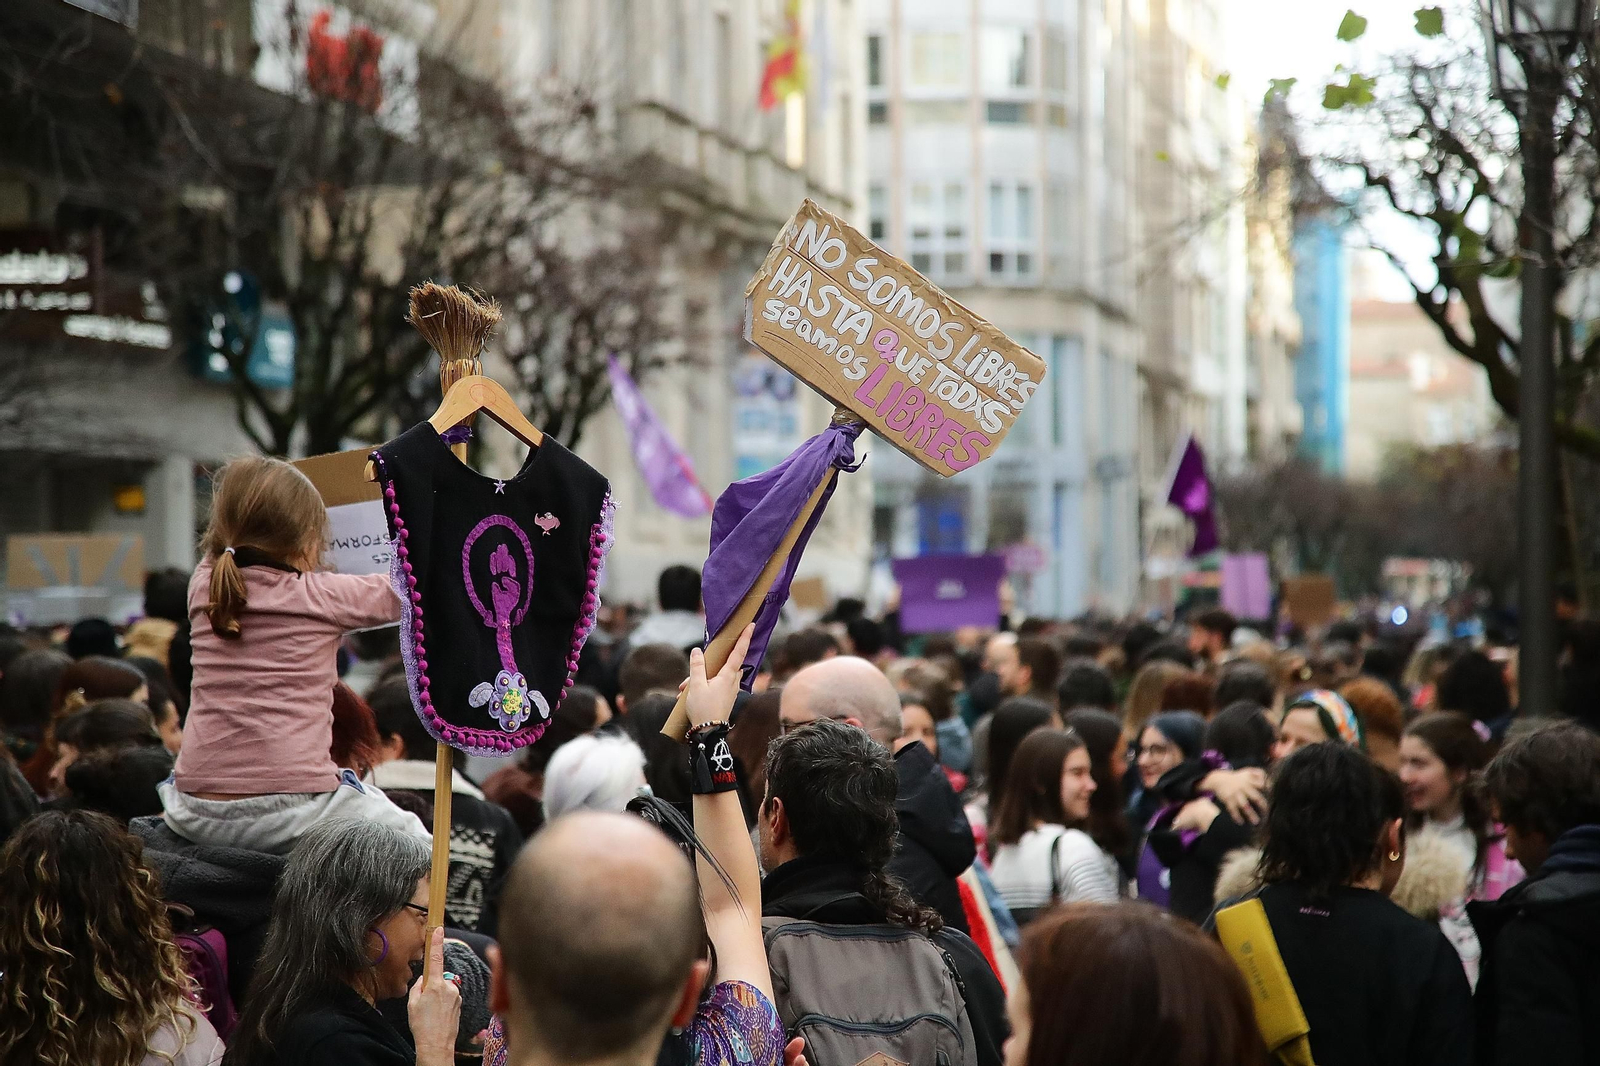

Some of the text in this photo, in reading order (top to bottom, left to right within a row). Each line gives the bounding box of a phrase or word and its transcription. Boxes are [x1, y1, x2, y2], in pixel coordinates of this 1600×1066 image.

[768, 256, 874, 347] HASTA
[873, 328, 933, 385] QUE
[794, 219, 847, 270] NO
[848, 257, 964, 361] SOMOS
[854, 363, 991, 472] LIBRES
